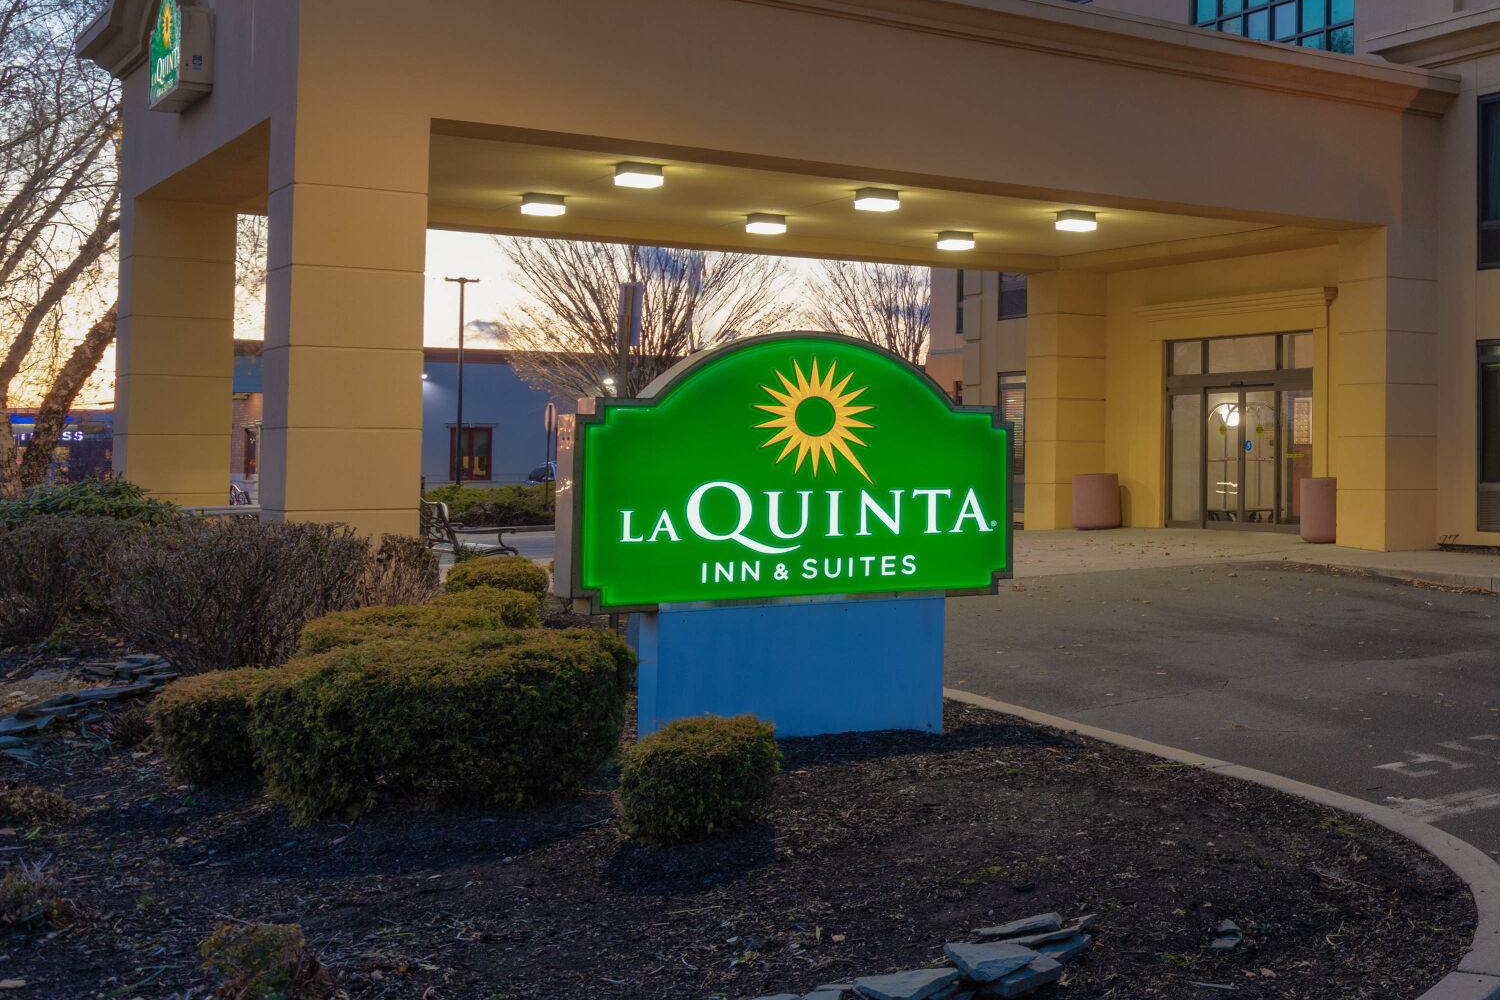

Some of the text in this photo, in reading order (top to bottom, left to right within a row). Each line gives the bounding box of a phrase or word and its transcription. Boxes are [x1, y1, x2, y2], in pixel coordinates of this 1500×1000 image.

[619, 481, 993, 554] LA QUINTA
[701, 554, 917, 583] INN & SUITES
